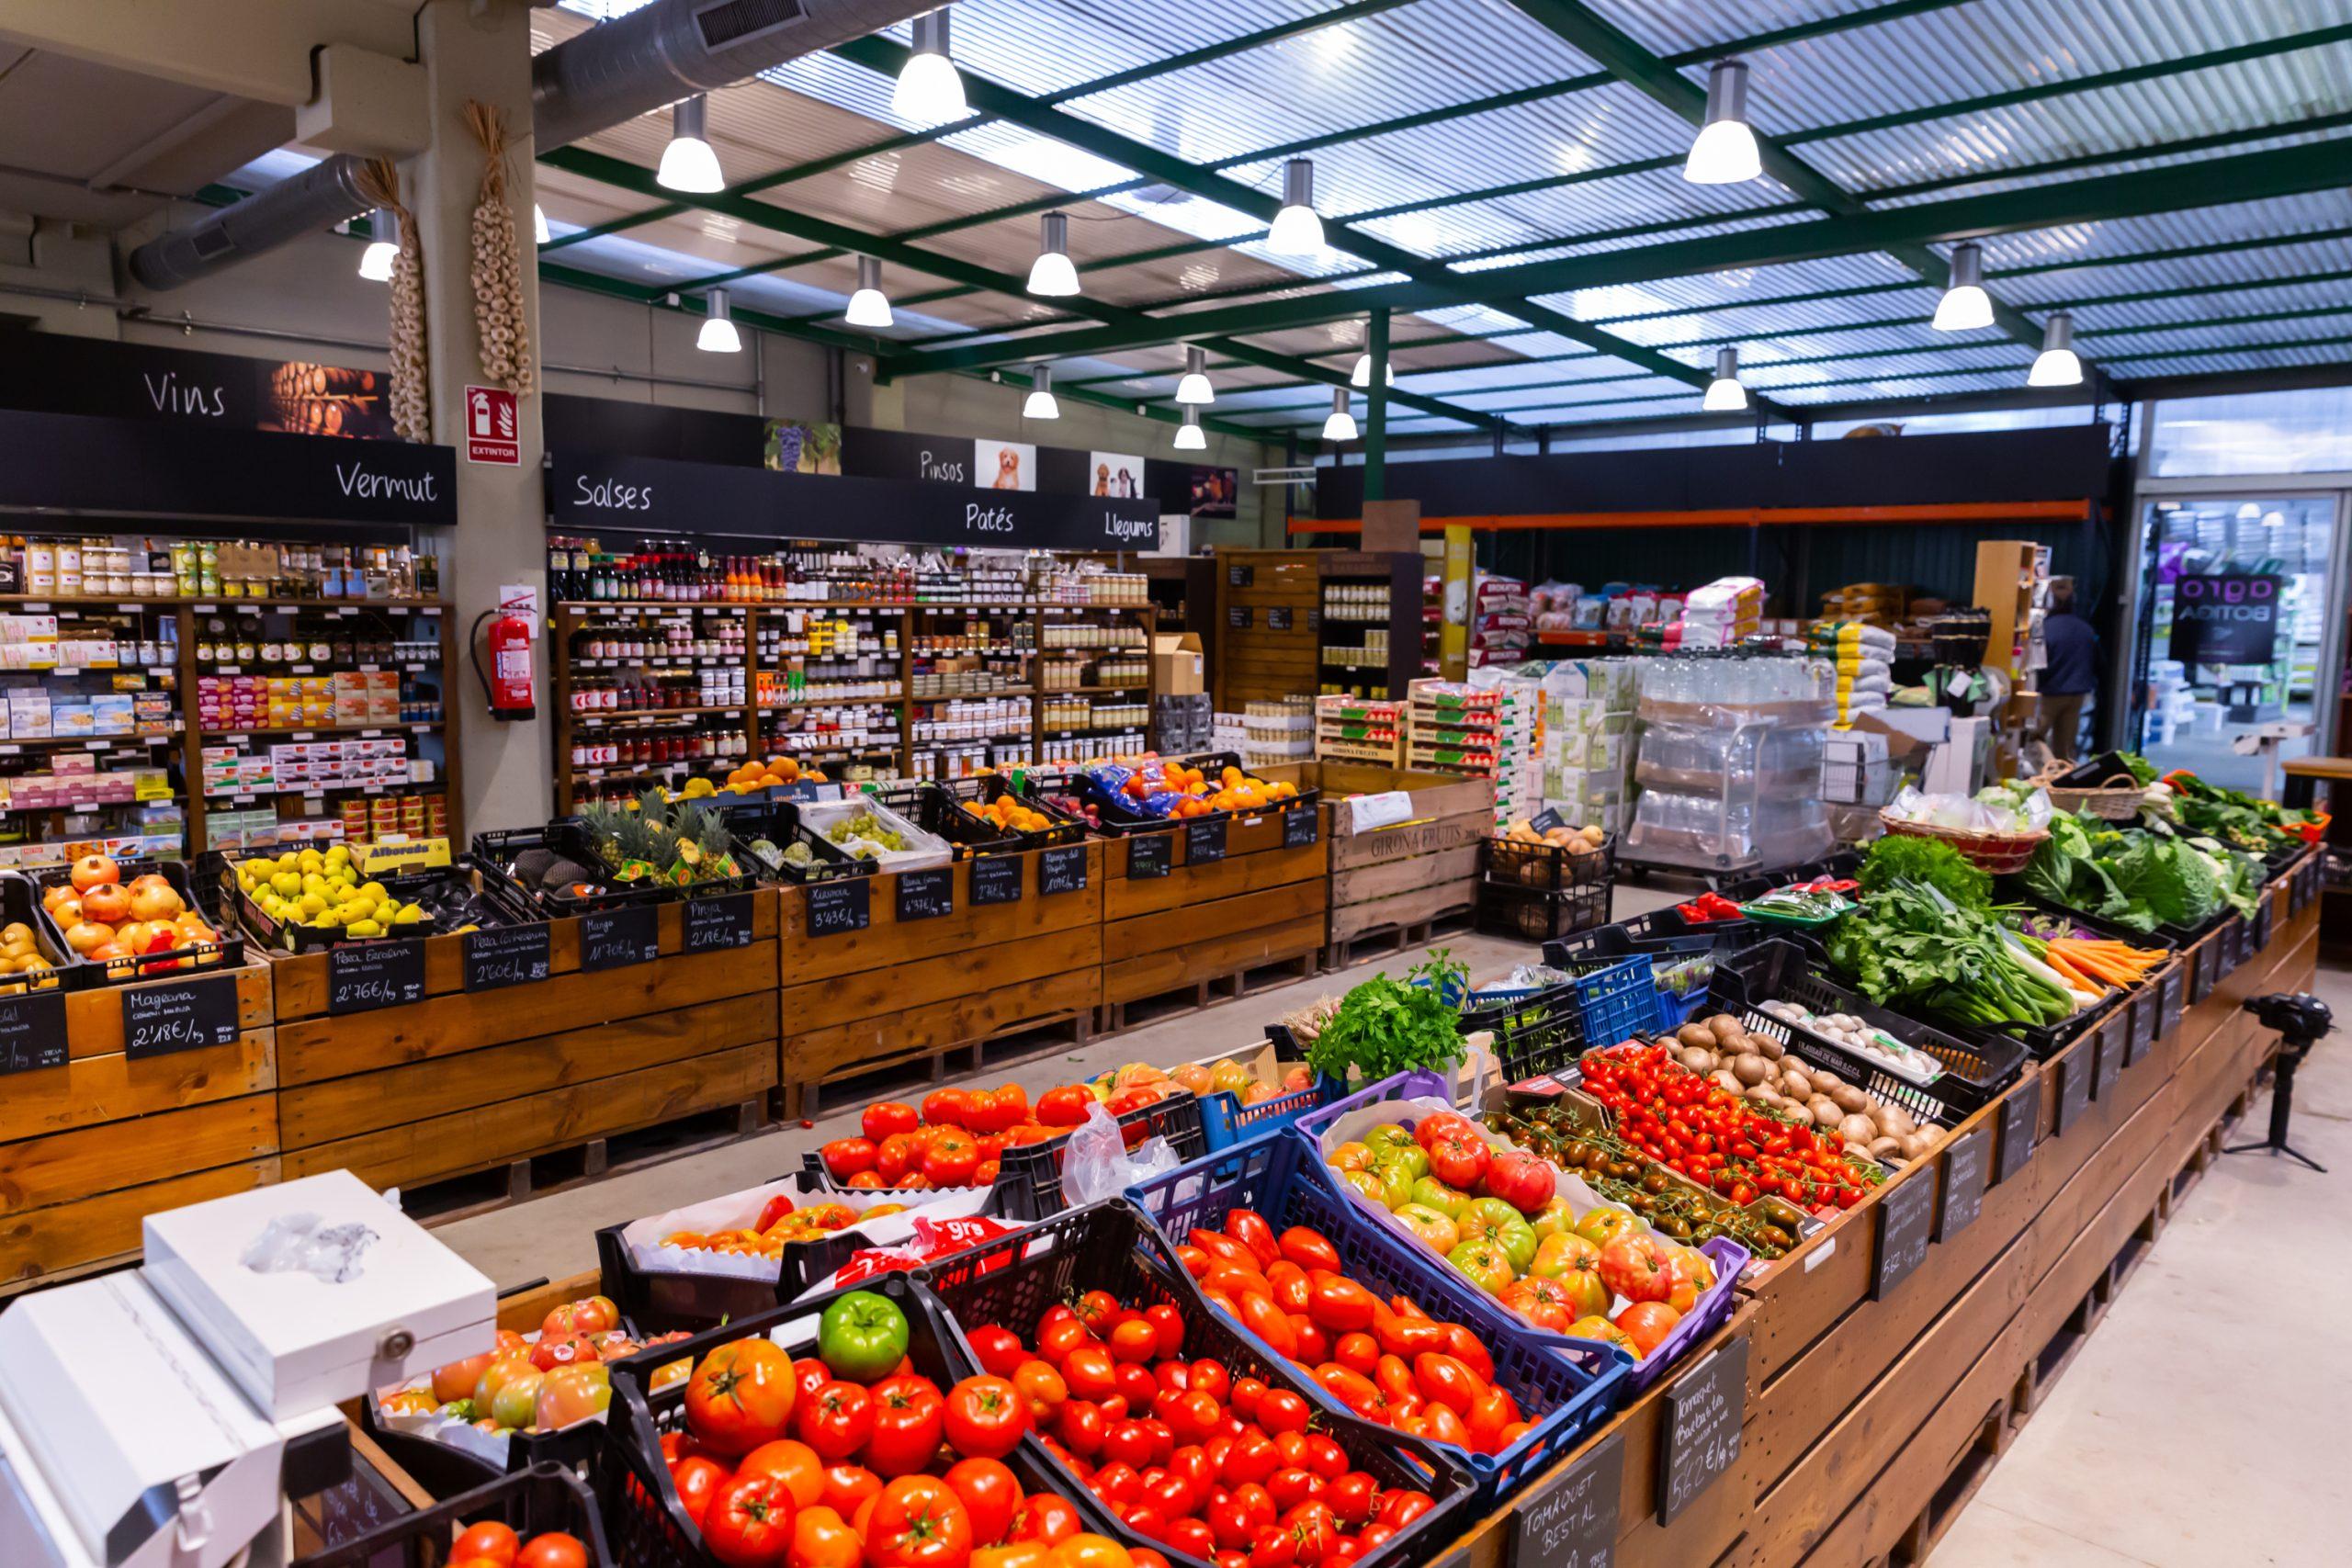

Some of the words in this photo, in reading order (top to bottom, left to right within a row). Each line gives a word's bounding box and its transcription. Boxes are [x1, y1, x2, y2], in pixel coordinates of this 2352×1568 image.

[144, 372, 225, 416] Vins
[472, 446, 515, 457] EXTINTOR
[921, 451, 964, 483] Pinsos
[335, 462, 438, 502] Vermut
[573, 475, 652, 510] Salses
[966, 502, 1014, 532] Patés
[1105, 512, 1153, 542] Llegums
[1371, 830, 1419, 857] GIRONA
[1422, 824, 1461, 848] FRUITS
[587, 919, 614, 933] Mango
[947, 1221, 985, 1240] grs
